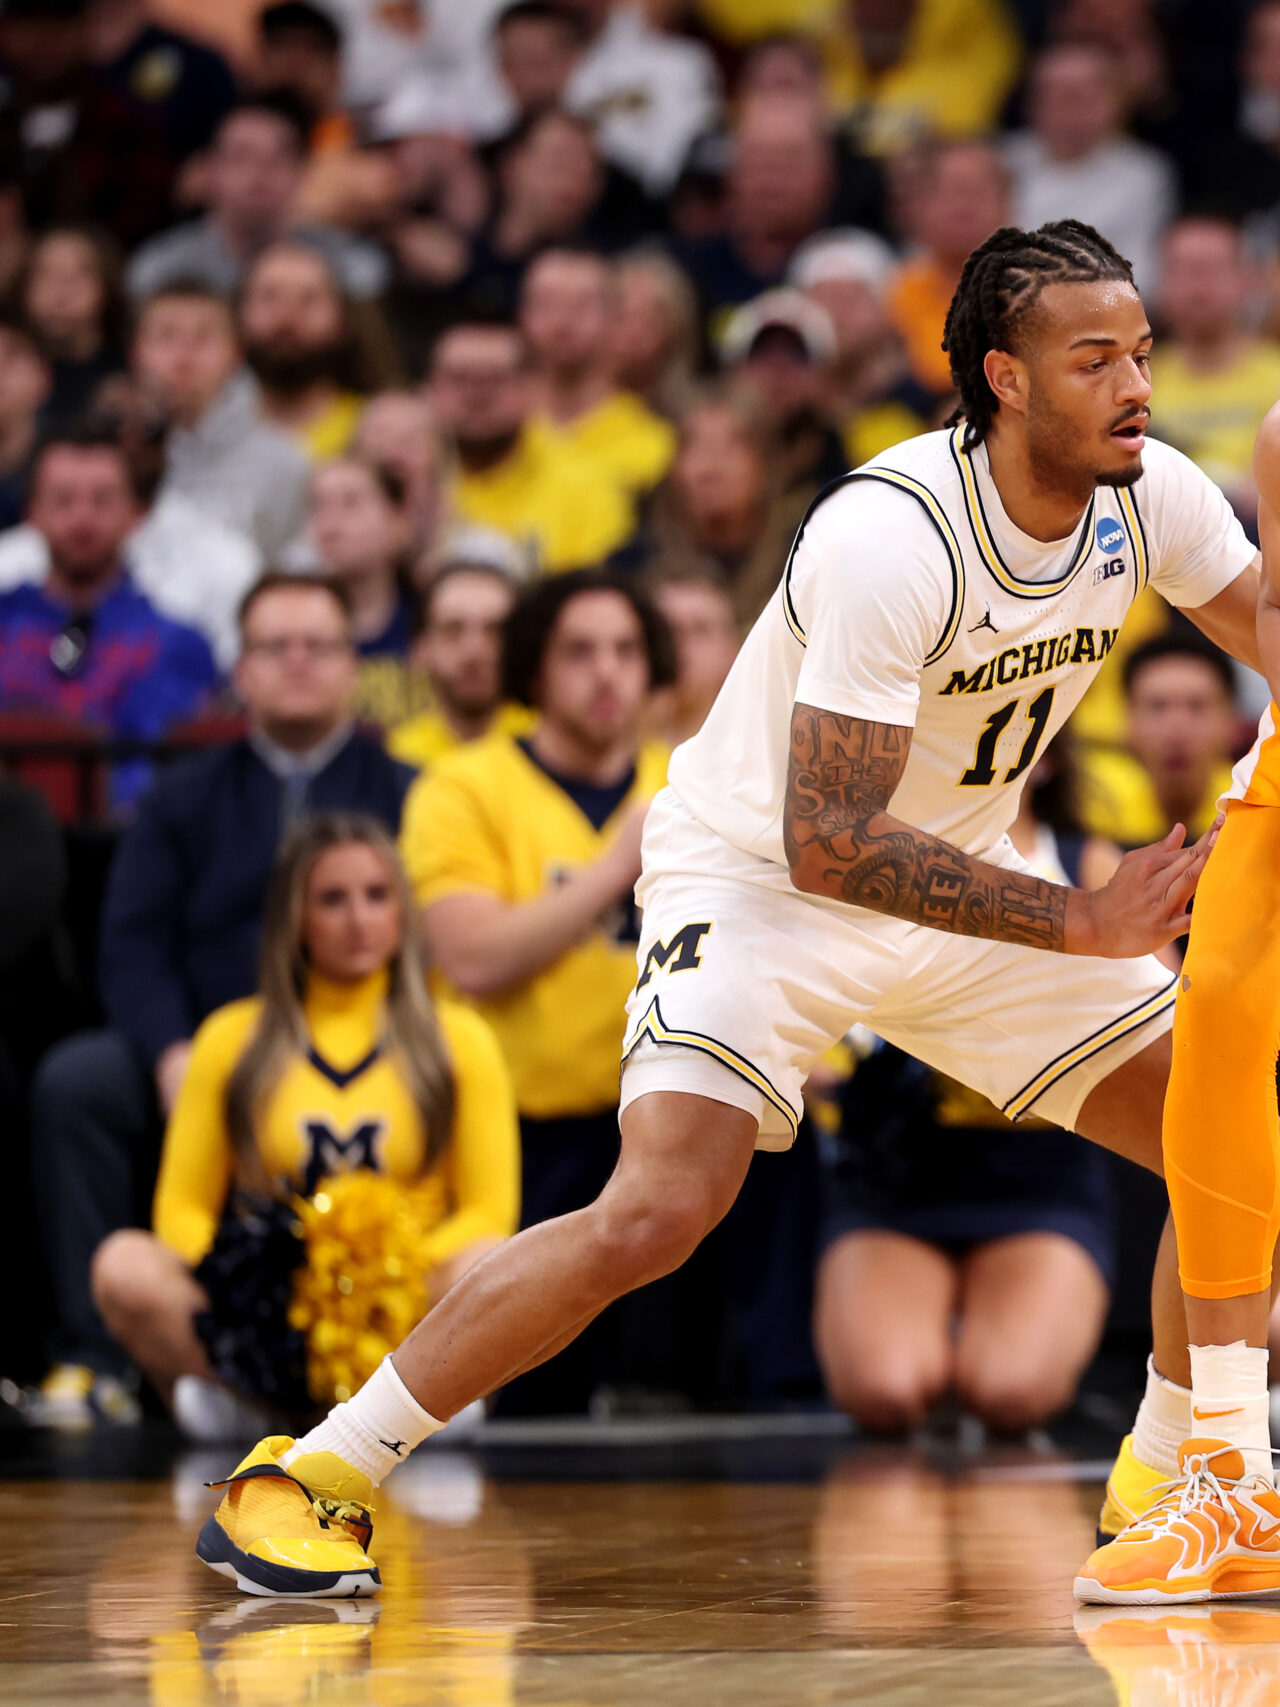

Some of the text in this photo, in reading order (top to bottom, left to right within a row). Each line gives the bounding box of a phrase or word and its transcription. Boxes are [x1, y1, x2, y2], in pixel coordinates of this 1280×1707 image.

[1100, 529, 1124, 548] NCAA
[936, 627, 1121, 696] MICHIGAN
[955, 683, 1057, 787] 11
[636, 921, 715, 996] M
[304, 1120, 381, 1198] M
